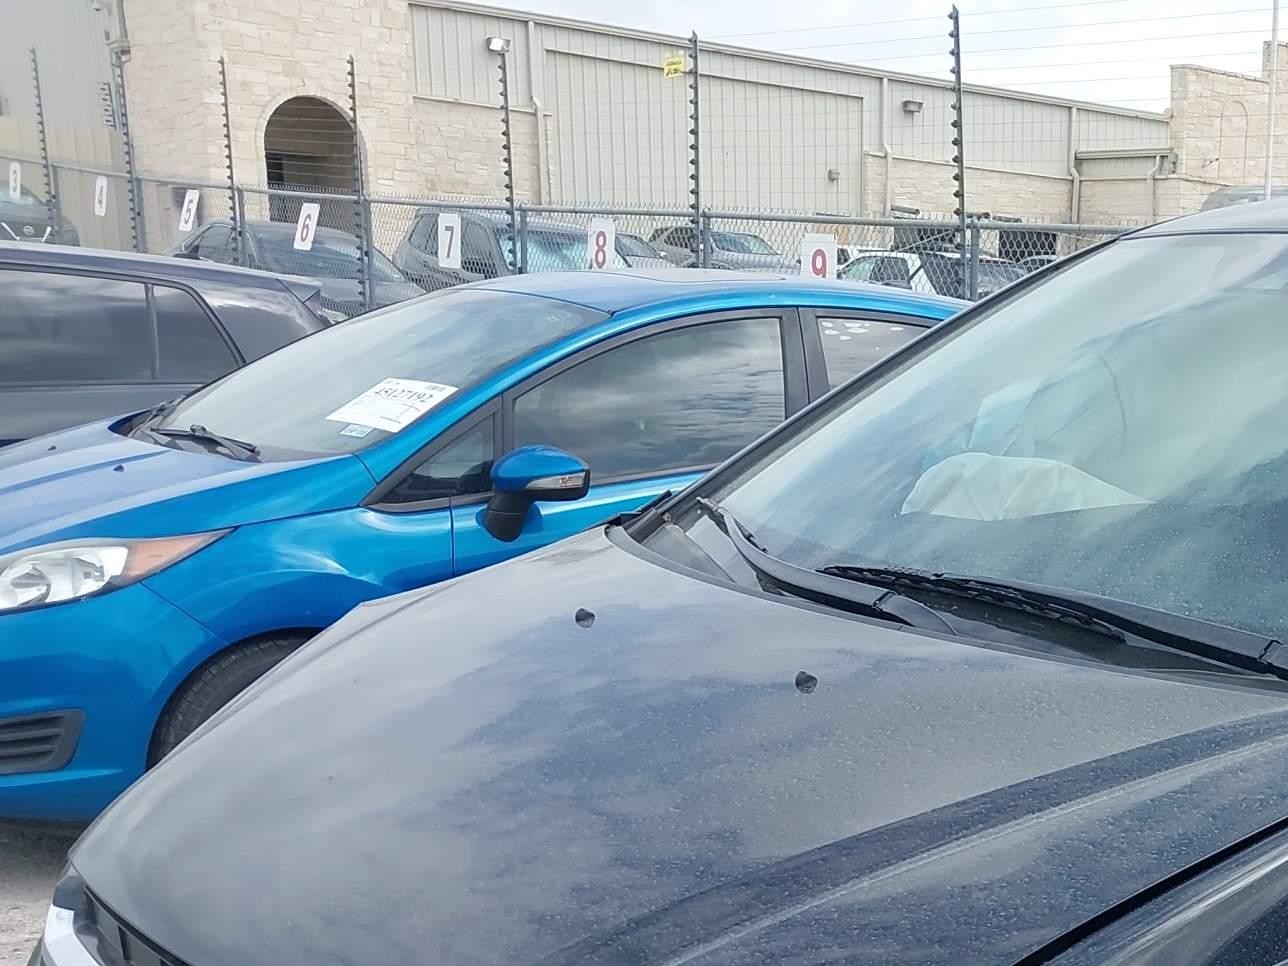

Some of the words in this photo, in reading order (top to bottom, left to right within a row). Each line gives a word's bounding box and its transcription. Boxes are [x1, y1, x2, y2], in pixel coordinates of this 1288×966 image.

[97, 184, 104, 209] 4
[184, 198, 194, 225] 5
[300, 213, 312, 243] 6
[444, 225, 455, 259] 7
[594, 230, 607, 269] 8
